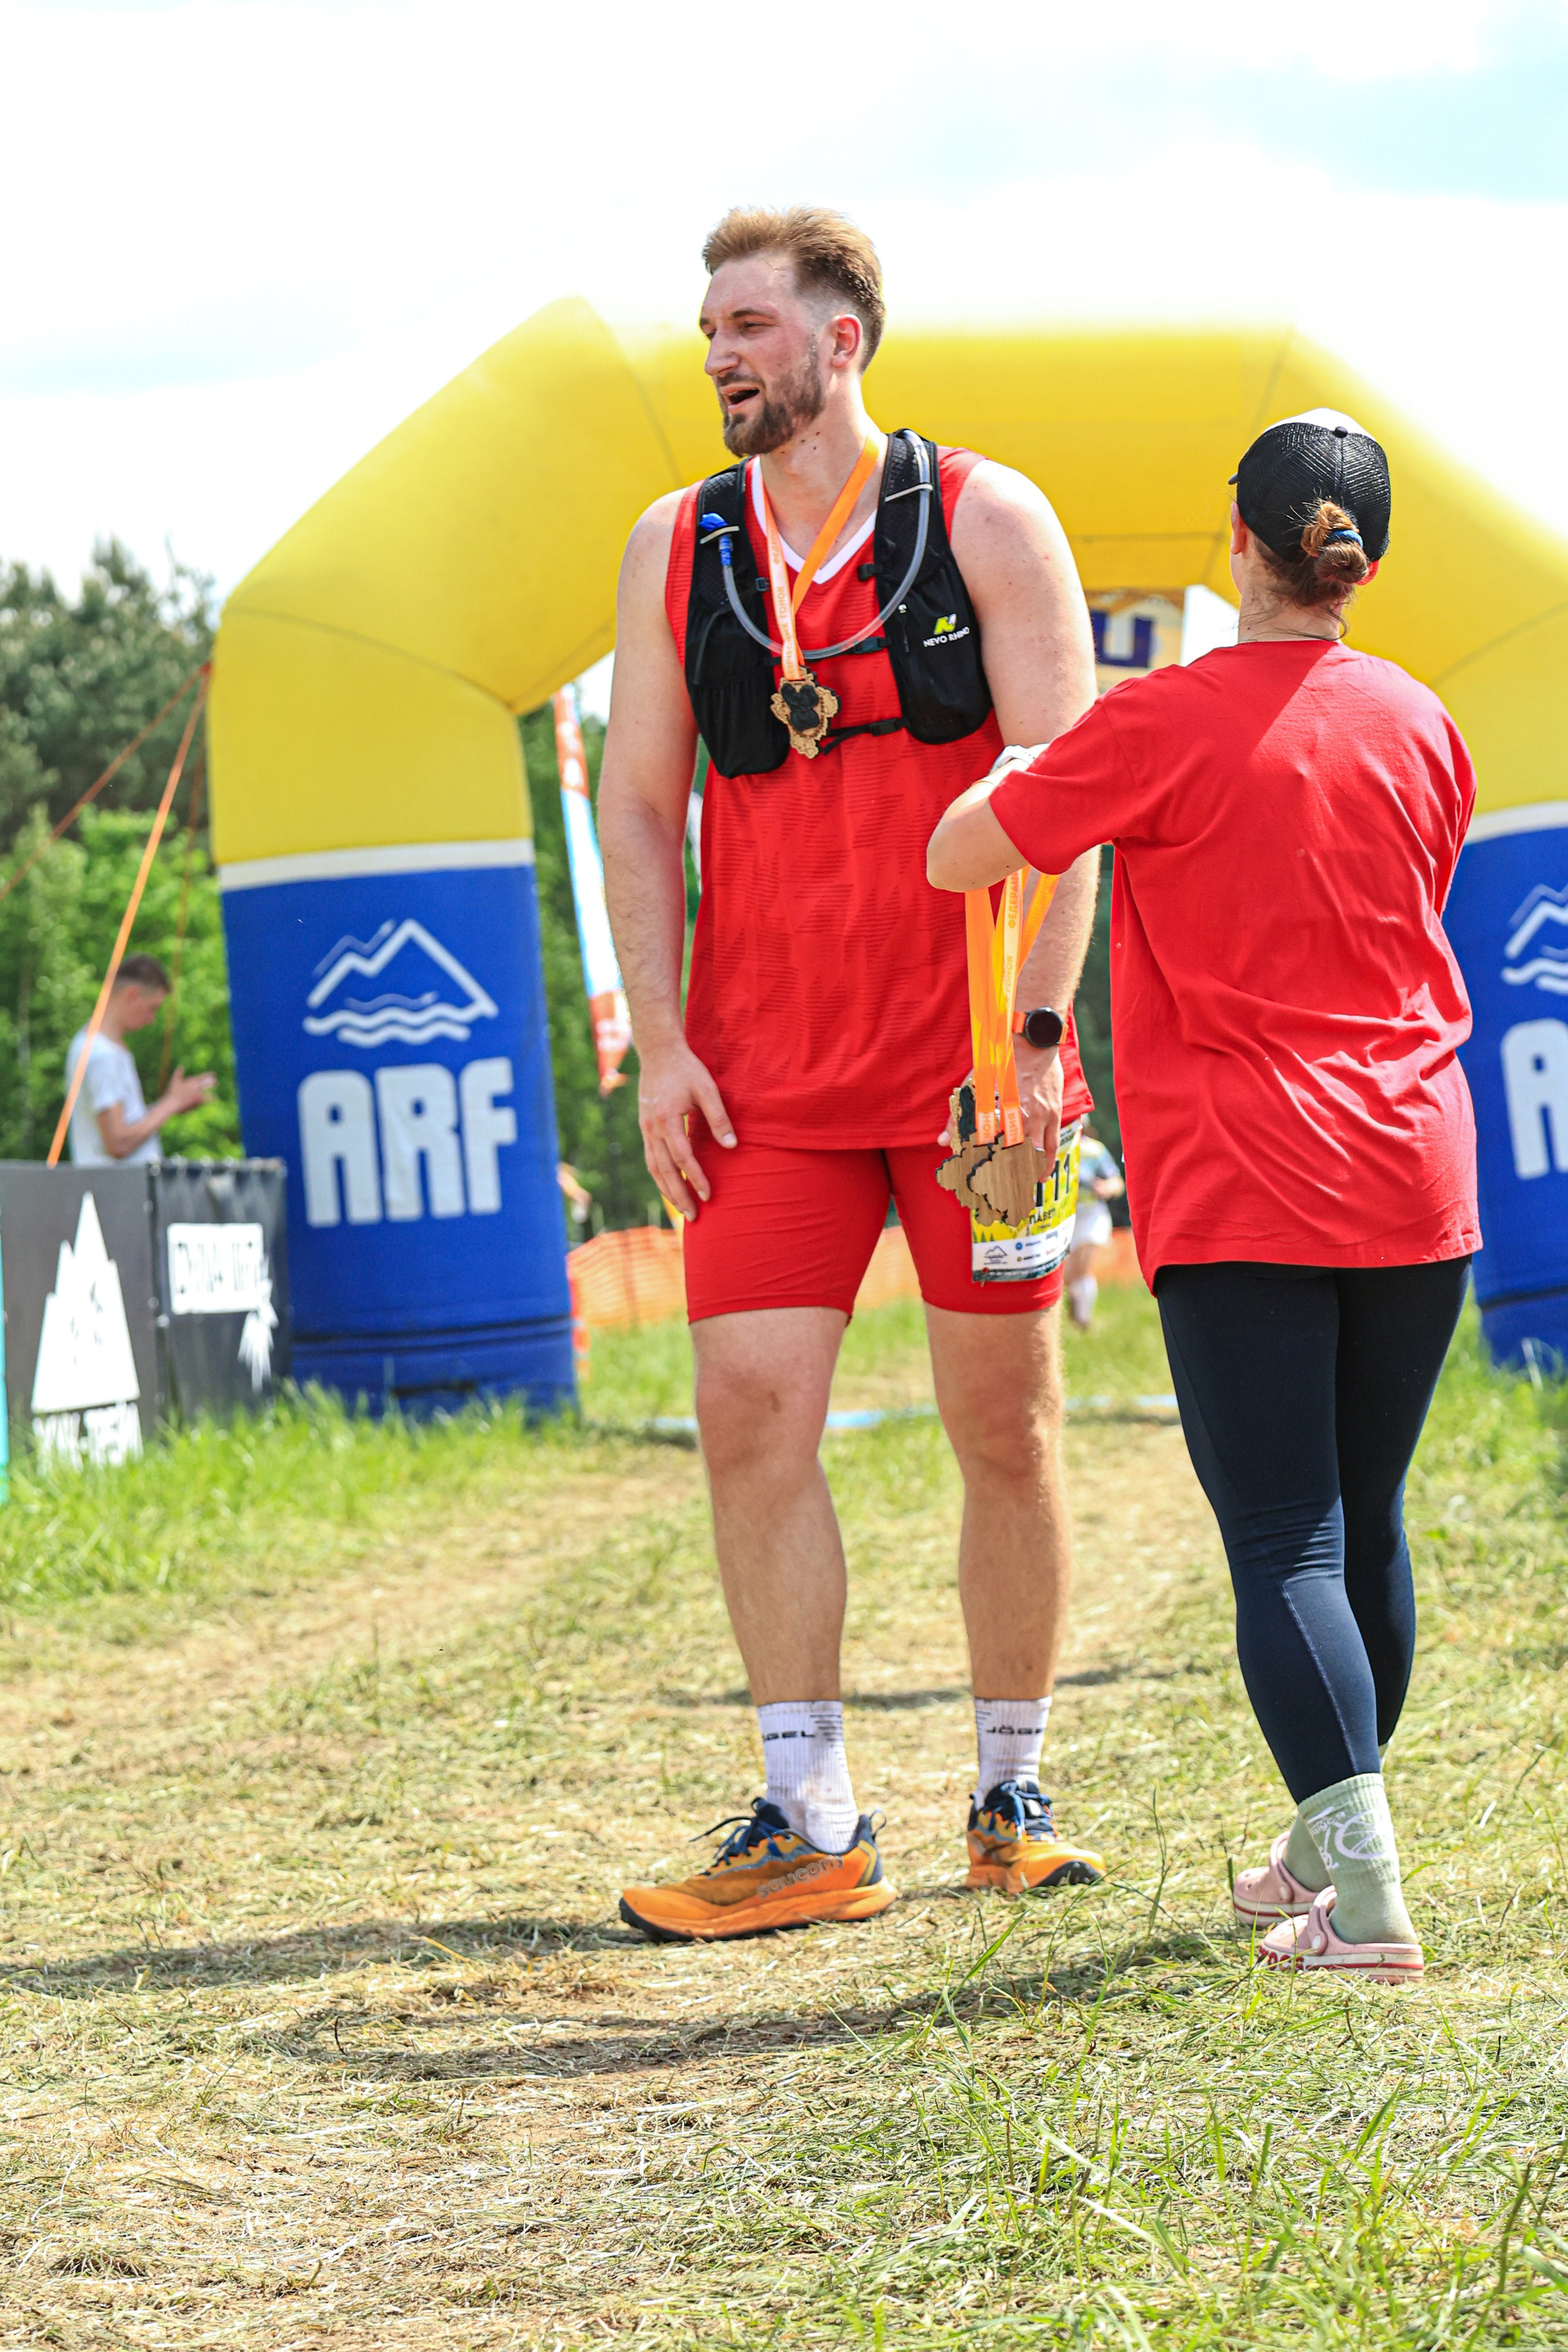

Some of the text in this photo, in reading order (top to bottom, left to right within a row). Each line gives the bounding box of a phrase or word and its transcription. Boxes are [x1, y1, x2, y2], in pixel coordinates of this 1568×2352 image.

[777, 586, 788, 619] ГОНОК
[923, 627, 970, 647] NEVO RHINO
[298, 1057, 518, 1229] ARF
[756, 1854, 844, 1899] saucony
